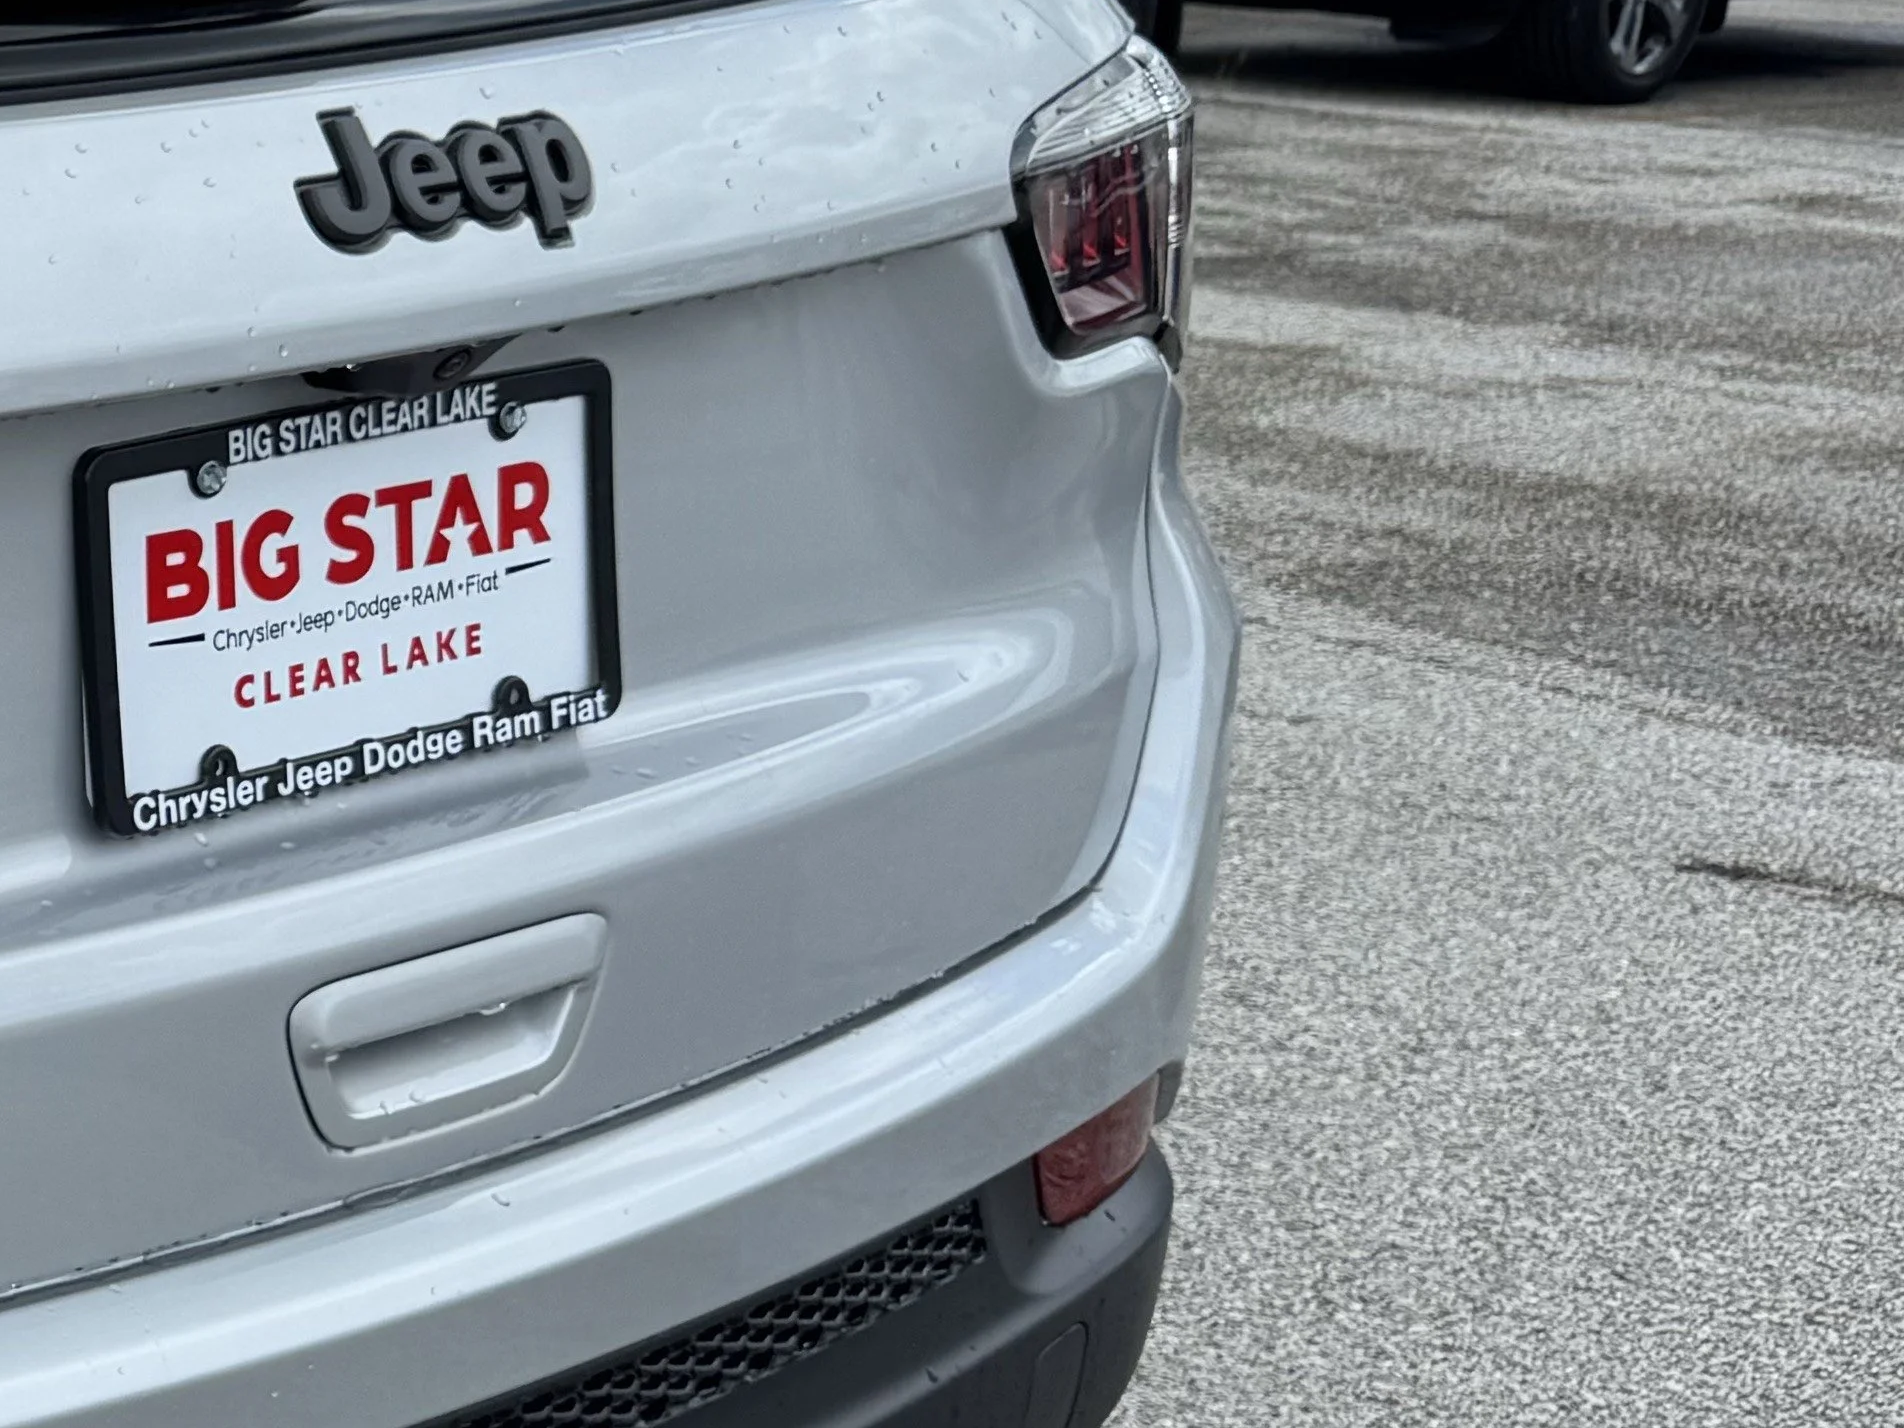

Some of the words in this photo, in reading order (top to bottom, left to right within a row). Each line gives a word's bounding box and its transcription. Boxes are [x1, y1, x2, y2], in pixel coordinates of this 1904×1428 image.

[293, 105, 597, 257] Jeep
[228, 427, 272, 464] BIG
[279, 410, 342, 453] STAR
[349, 396, 429, 439] CLEAR
[436, 382, 496, 420] LAKE
[146, 509, 300, 623] BIG
[324, 461, 551, 585] STAR
[234, 650, 361, 708] CLEAR
[381, 623, 482, 676] LAKE
[133, 775, 268, 831] Chrysler
[277, 753, 353, 796] Jeep
[363, 729, 464, 775] Dodge
[472, 710, 542, 748] Ram
[550, 687, 608, 730] Fiat
